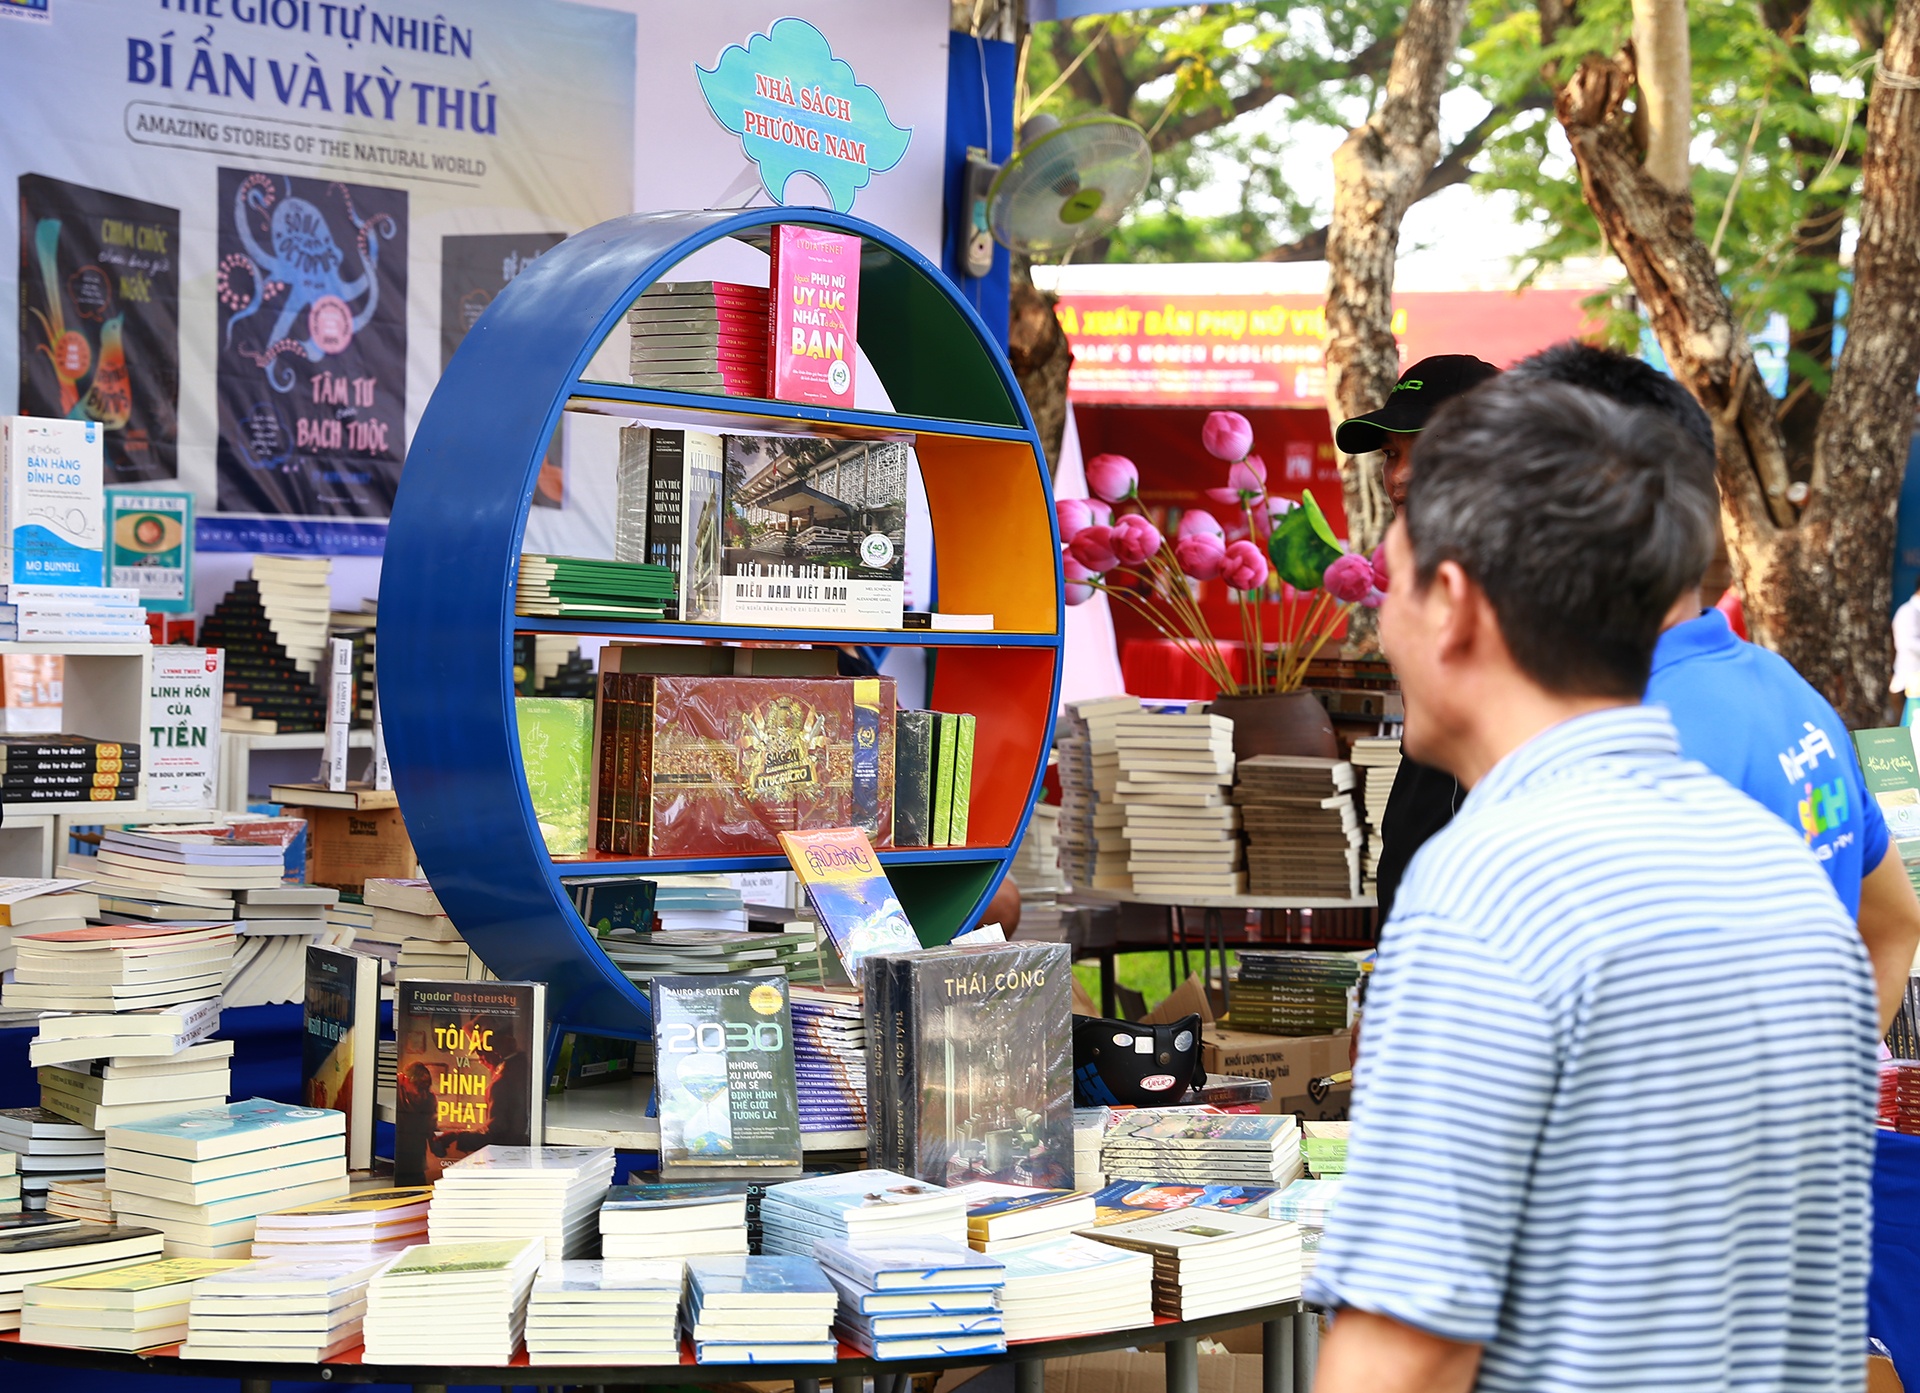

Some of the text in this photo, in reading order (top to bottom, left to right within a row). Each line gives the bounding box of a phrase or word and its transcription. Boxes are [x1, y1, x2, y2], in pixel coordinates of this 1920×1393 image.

[320, 3, 366, 49] TỰ
[370, 14, 473, 60] NHIÊN
[126, 24, 498, 136] BÍ ẨN VÀ KỲ THÚ
[756, 73, 852, 122] NHÀ SÁCH
[135, 113, 486, 177] AMAZING STORIES OF THE NATURAL WORLD
[744, 110, 866, 164] PHƯƠNG NAM
[797, 240, 843, 254] LYDIA FENET
[810, 272, 830, 289] PHỤ
[831, 274, 847, 289] NỮ
[793, 286, 847, 314] UY LỰC
[793, 308, 826, 326] NHẤT
[791, 327, 844, 361] BẠN
[310, 370, 349, 405] TÂM
[1392, 379, 1423, 393] NC
[296, 417, 342, 453] BẠCH
[347, 418, 389, 456] TUỘC
[27, 455, 81, 470] BÁN HÀNG
[57, 473, 81, 486] CAO
[668, 503, 680, 513] NAM
[668, 515, 680, 525] NAM
[44, 561, 81, 573] BUNNELL
[736, 559, 762, 578] KIẾN
[799, 563, 825, 582] HIỆN
[736, 581, 847, 601] MIỀN NAM VIỆT NAM
[151, 683, 210, 698] LINH HỒN
[167, 702, 192, 715] CỦA
[150, 720, 207, 748] TIỀN
[706, 988, 740, 996] GUILLÉN
[944, 969, 1045, 997] THÁI CÔNG
[414, 990, 517, 1006] Fyodor Dostoevsky
[896, 1011, 905, 1039] THÁI
[434, 1023, 494, 1055] TỘI ÁC
[667, 1022, 783, 1053] 2030
[456, 1054, 471, 1068] VÀ
[729, 1060, 758, 1070] NHỮNG
[896, 1042, 905, 1076] CÔNG
[439, 1068, 486, 1096] HÌNH
[729, 1071, 740, 1080] XU
[731, 1090, 778, 1101] ĐỊNH HÌNH
[731, 1101, 748, 1110] THẾ
[437, 1101, 488, 1129] PHẠT
[763, 1111, 778, 1119] LAI
[896, 1109, 904, 1153] PASSION
